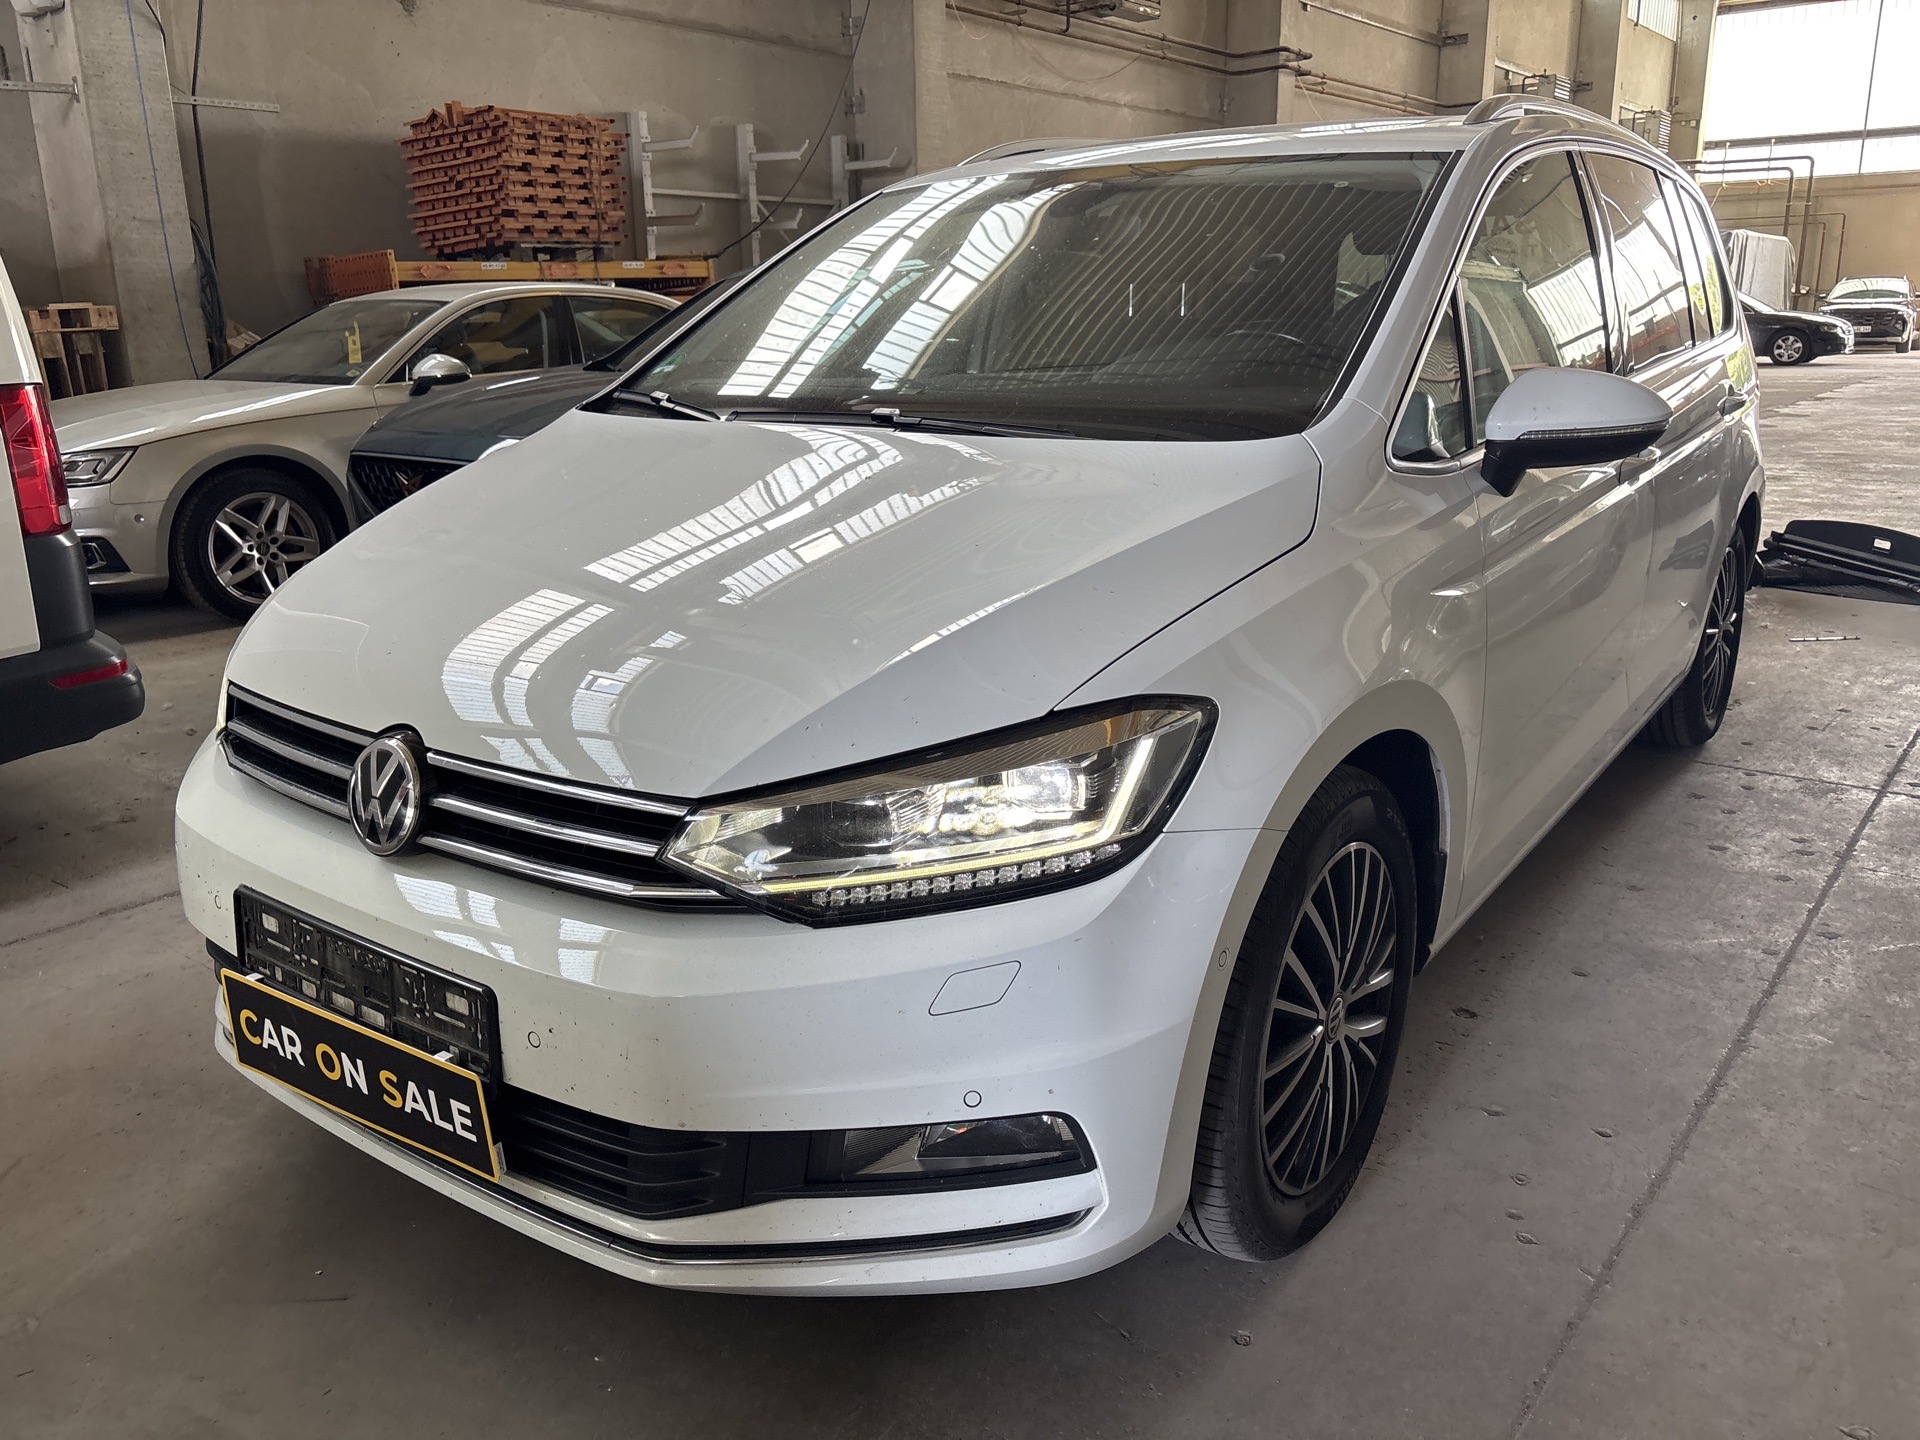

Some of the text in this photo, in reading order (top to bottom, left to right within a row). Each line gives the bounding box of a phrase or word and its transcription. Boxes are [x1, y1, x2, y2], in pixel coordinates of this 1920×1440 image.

[239, 1008, 478, 1143] CAR ON SALE
